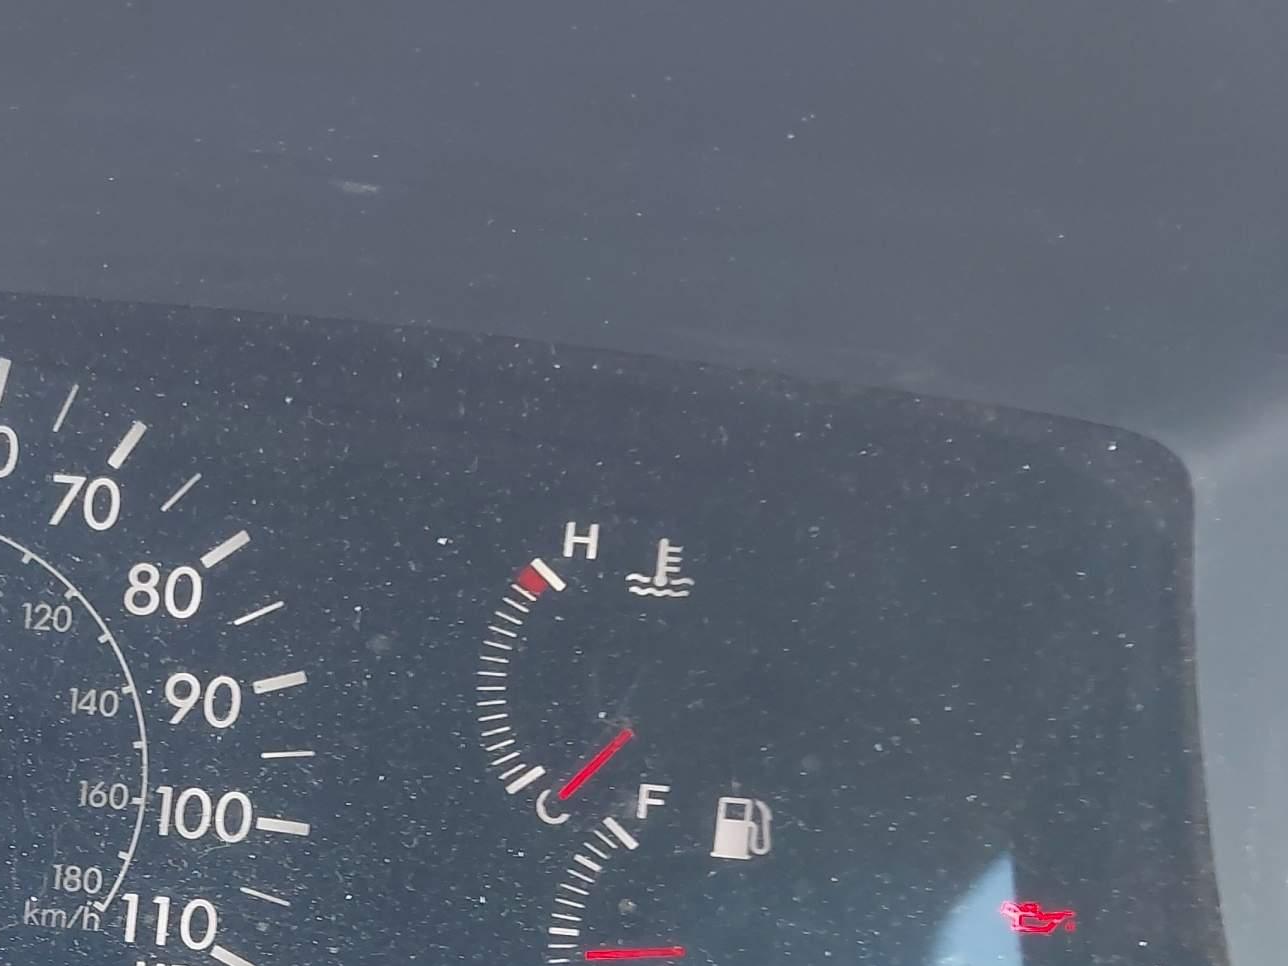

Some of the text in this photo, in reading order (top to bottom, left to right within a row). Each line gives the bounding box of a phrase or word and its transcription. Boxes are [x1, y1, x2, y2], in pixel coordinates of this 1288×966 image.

[48, 475, 120, 531] 70
[564, 521, 599, 560] H
[125, 563, 202, 618] 80
[23, 601, 72, 632] 120
[71, 687, 119, 717] 140
[164, 673, 240, 728] 90
[78, 780, 128, 809] 160
[536, 790, 569, 825] C
[636, 783, 671, 820] F
[157, 786, 252, 843] 100
[52, 864, 102, 893] 180
[24, 901, 100, 929] km/h
[123, 893, 218, 951] 110
